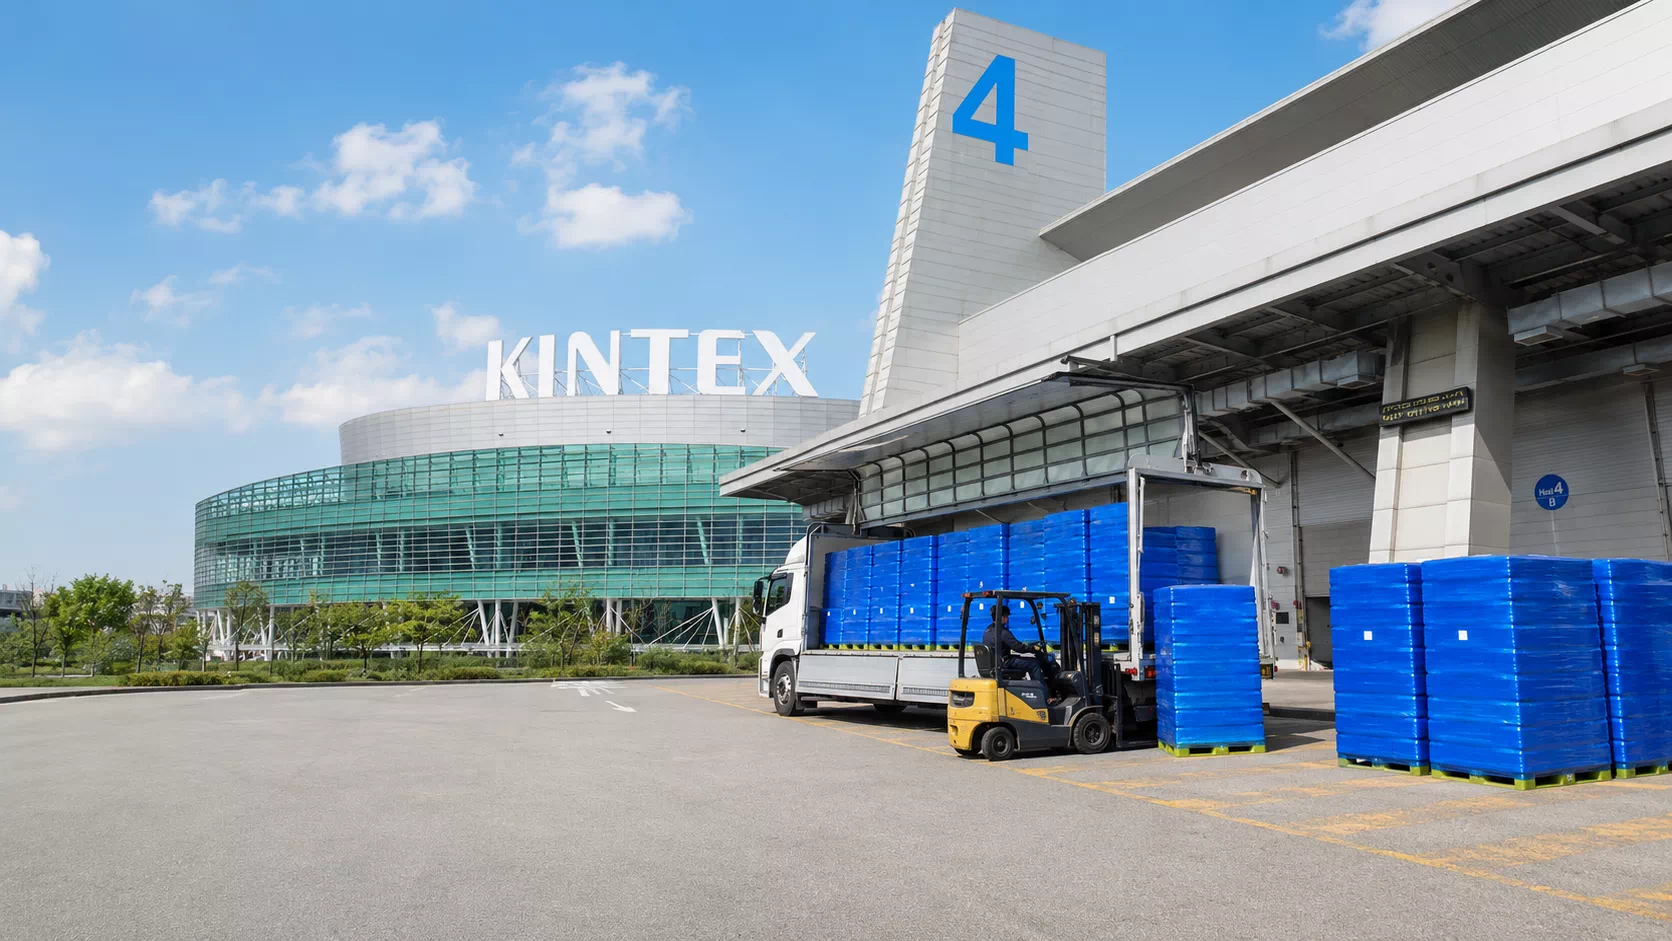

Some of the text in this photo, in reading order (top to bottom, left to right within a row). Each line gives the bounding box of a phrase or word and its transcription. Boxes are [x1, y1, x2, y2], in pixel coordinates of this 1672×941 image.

[952, 54, 1028, 166] 4
[485, 328, 818, 401] KINTEX
[1554, 481, 1563, 494] 4
